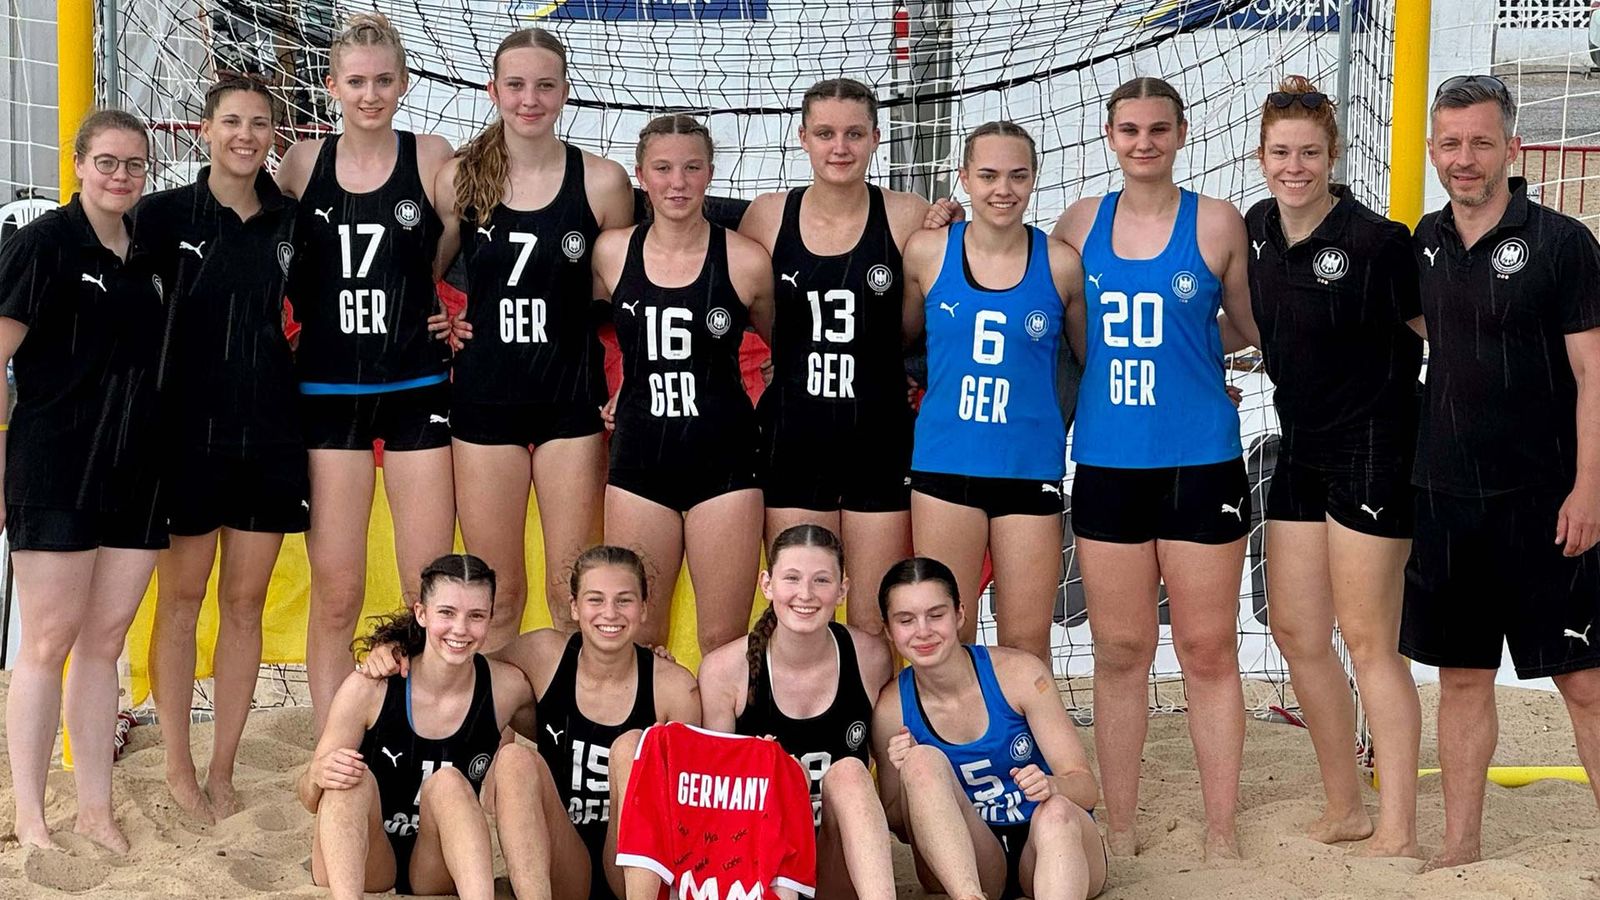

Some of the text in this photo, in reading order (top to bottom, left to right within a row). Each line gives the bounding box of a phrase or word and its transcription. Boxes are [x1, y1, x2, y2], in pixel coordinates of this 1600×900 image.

[339, 224, 385, 278] 17
[507, 231, 537, 286] 7
[340, 289, 387, 335] GER
[500, 298, 548, 344] GER
[645, 307, 692, 361] 16
[807, 290, 854, 343] 13
[1101, 292, 1163, 348] 20
[973, 310, 1007, 365] 6
[649, 372, 698, 418] GER
[807, 352, 855, 398] GER
[959, 375, 1009, 423] GER
[1110, 359, 1156, 406] GER
[572, 739, 610, 792] 15
[960, 759, 1005, 802] 5
[677, 772, 769, 811] GERMANY
